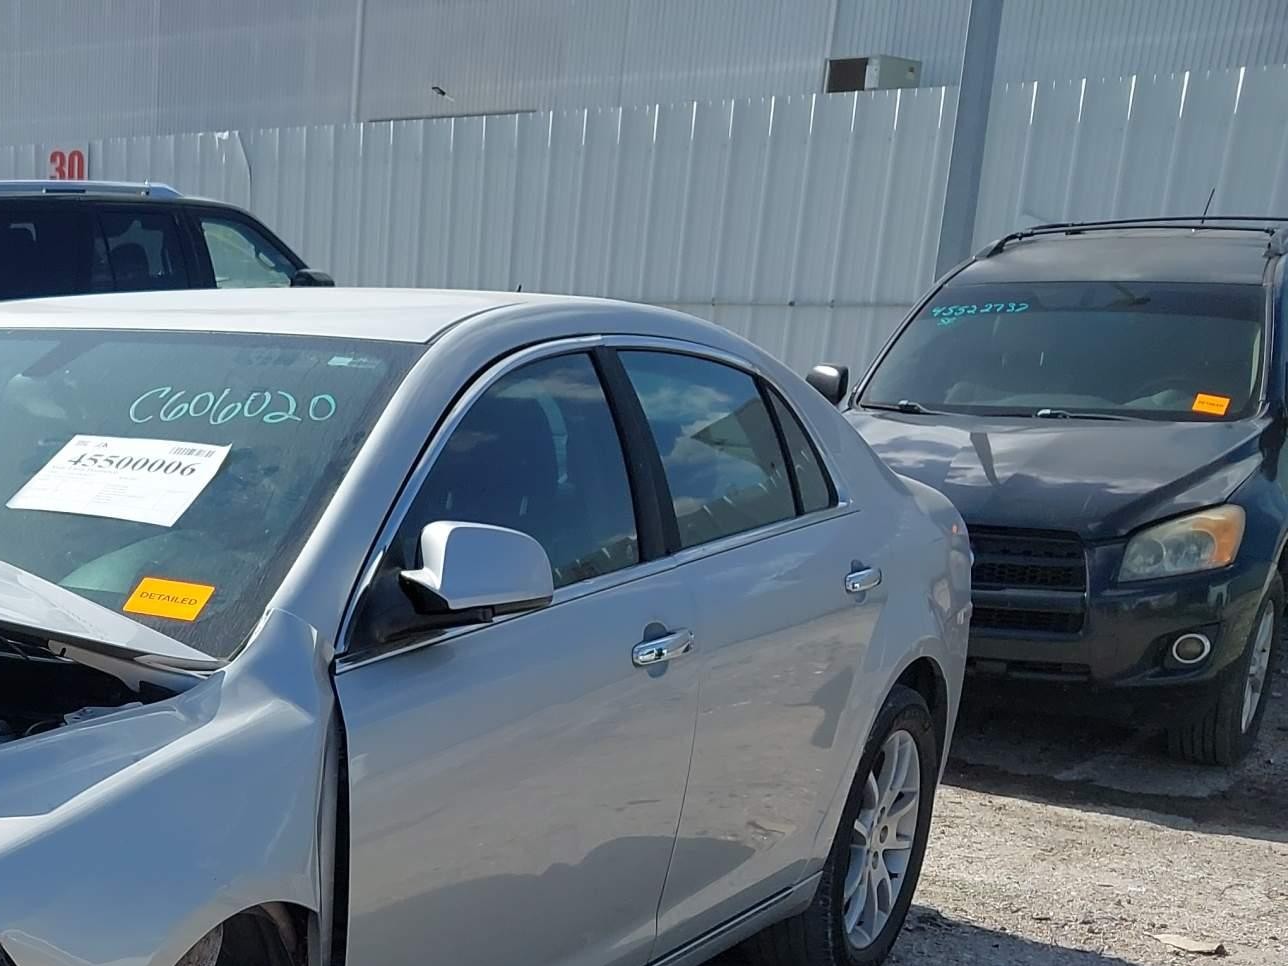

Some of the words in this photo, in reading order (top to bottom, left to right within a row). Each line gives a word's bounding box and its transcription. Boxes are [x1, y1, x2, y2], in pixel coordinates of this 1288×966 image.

[49, 150, 85, 181] 30
[128, 385, 338, 426] C606020
[67, 452, 201, 478] 45500006
[139, 591, 199, 607] DETAILED
